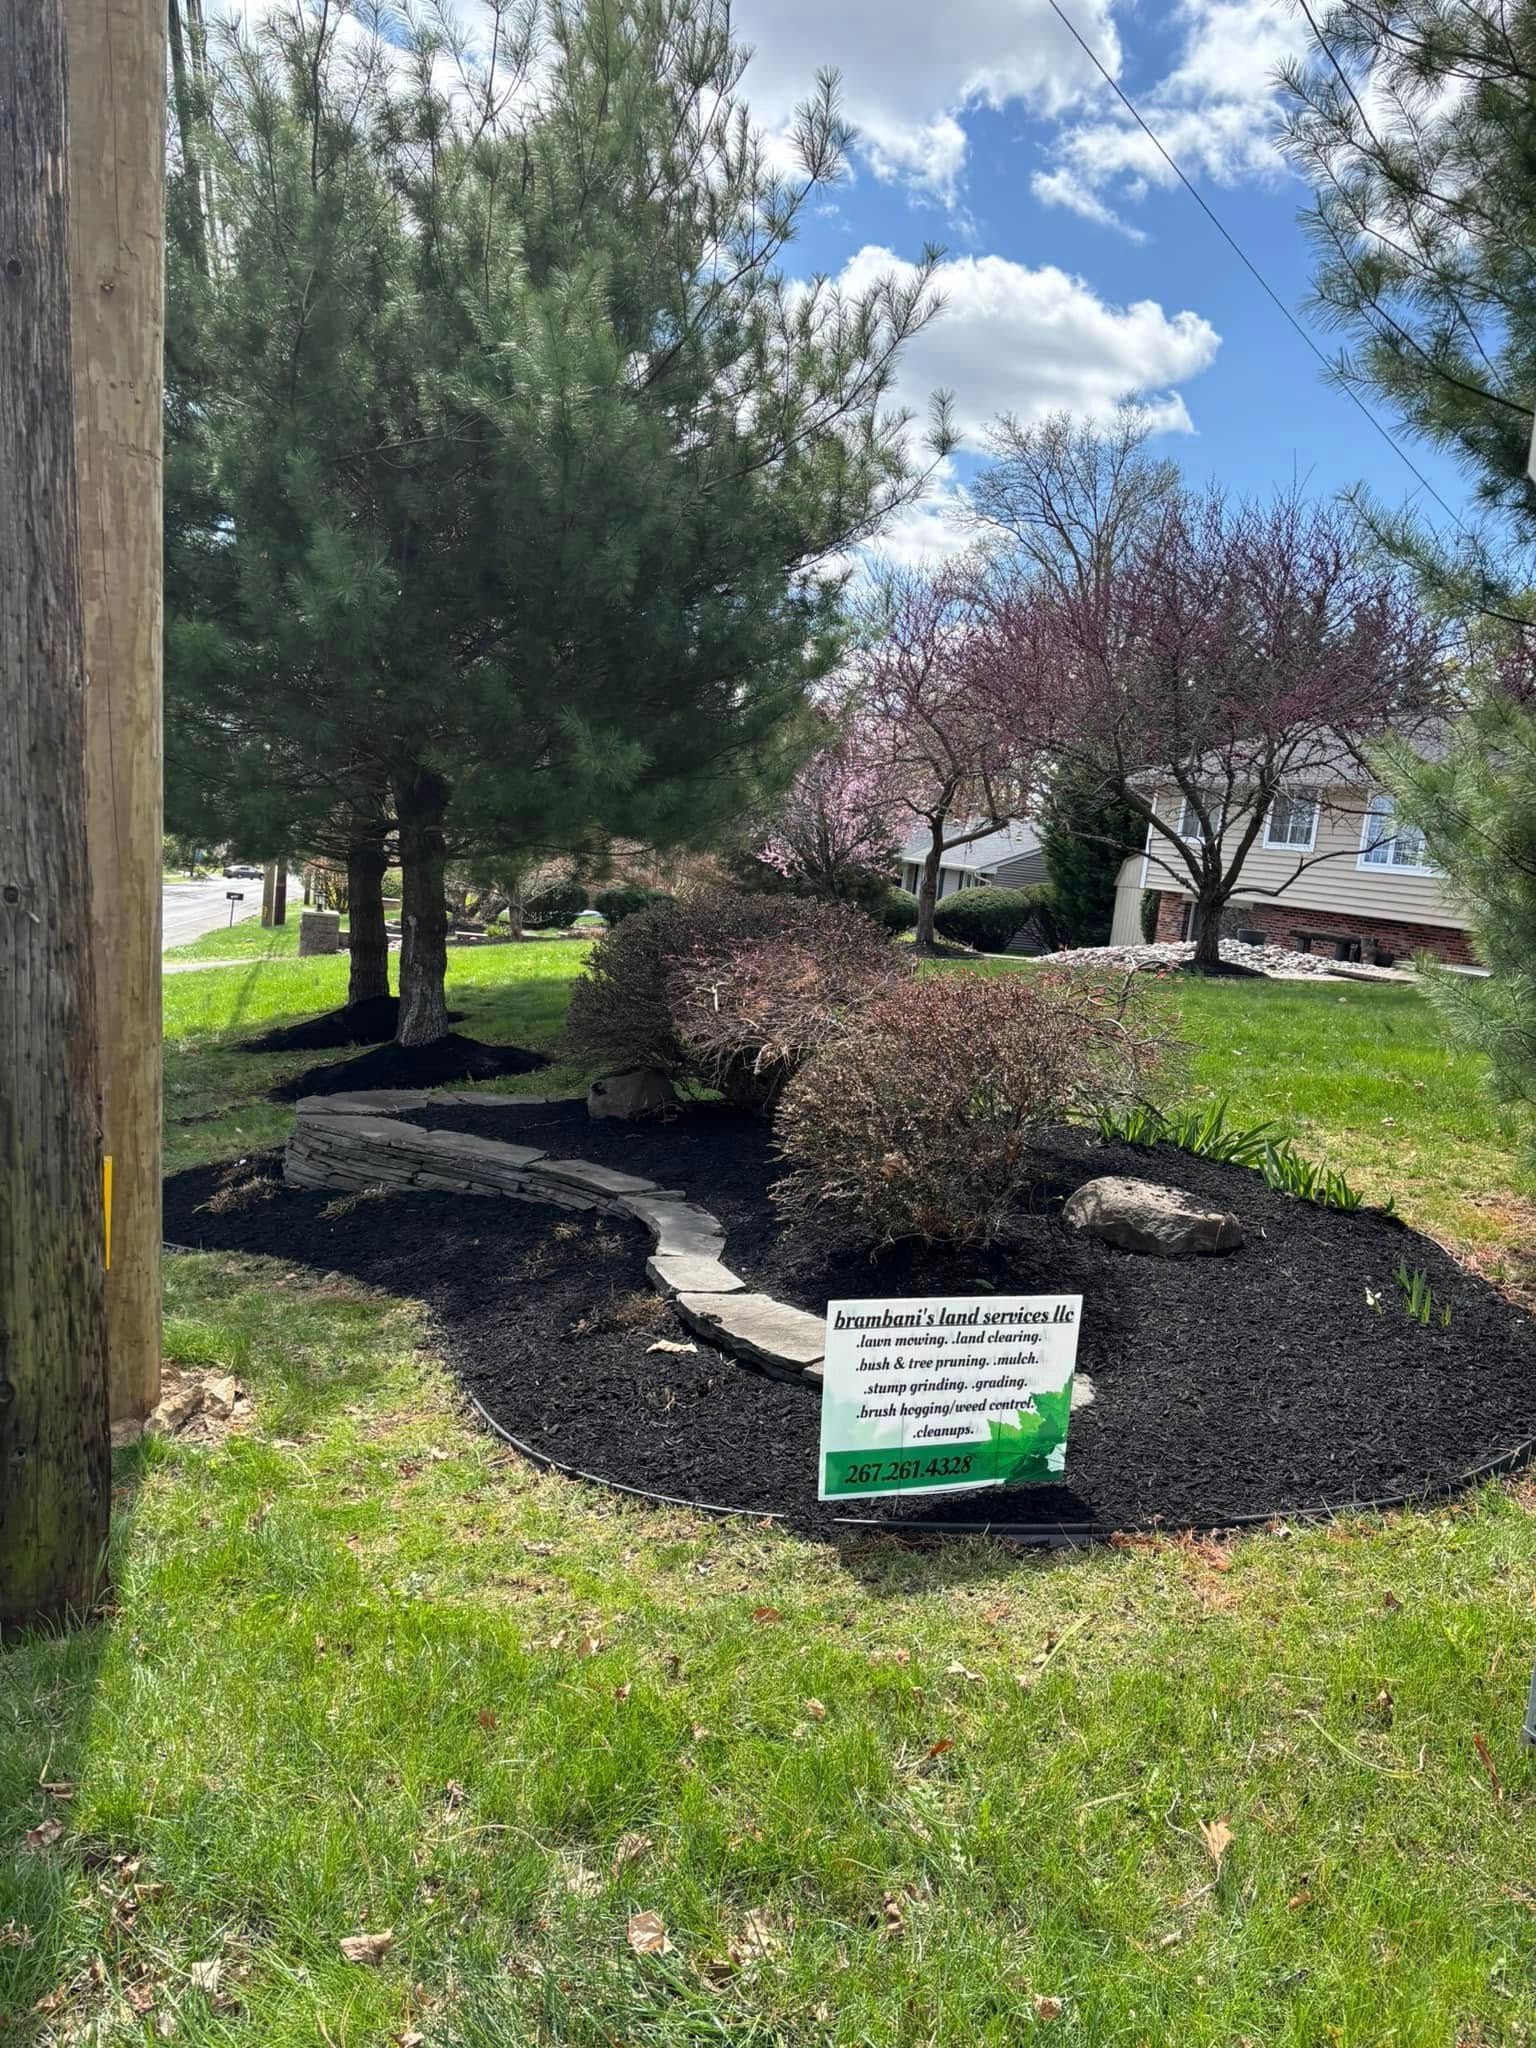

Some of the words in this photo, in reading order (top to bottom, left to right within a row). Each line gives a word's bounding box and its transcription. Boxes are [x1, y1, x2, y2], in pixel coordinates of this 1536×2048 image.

[834, 1308, 935, 1329] brambani's
[939, 1307, 980, 1326] land
[983, 1306, 1049, 1325] services
[1053, 1305, 1075, 1324] llc
[856, 1334, 891, 1348] .lawn
[895, 1334, 949, 1350] mowing.
[952, 1330, 985, 1345] .land
[987, 1331, 1042, 1346] clearing.
[856, 1358, 890, 1372] .bush
[894, 1356, 905, 1369] &
[908, 1357, 933, 1369] tree
[935, 1356, 990, 1371] pruning.
[993, 1352, 1039, 1366] .mulch.
[864, 1381, 907, 1396] .stump
[910, 1378, 968, 1394] grinding.
[971, 1376, 1028, 1391] .grading.
[856, 1405, 897, 1419] .brush
[900, 1398, 986, 1418] hogging/weed
[989, 1397, 1035, 1411] control.
[912, 1424, 974, 1439] .cleanups.
[845, 1455, 973, 1484] 267.261.4328
